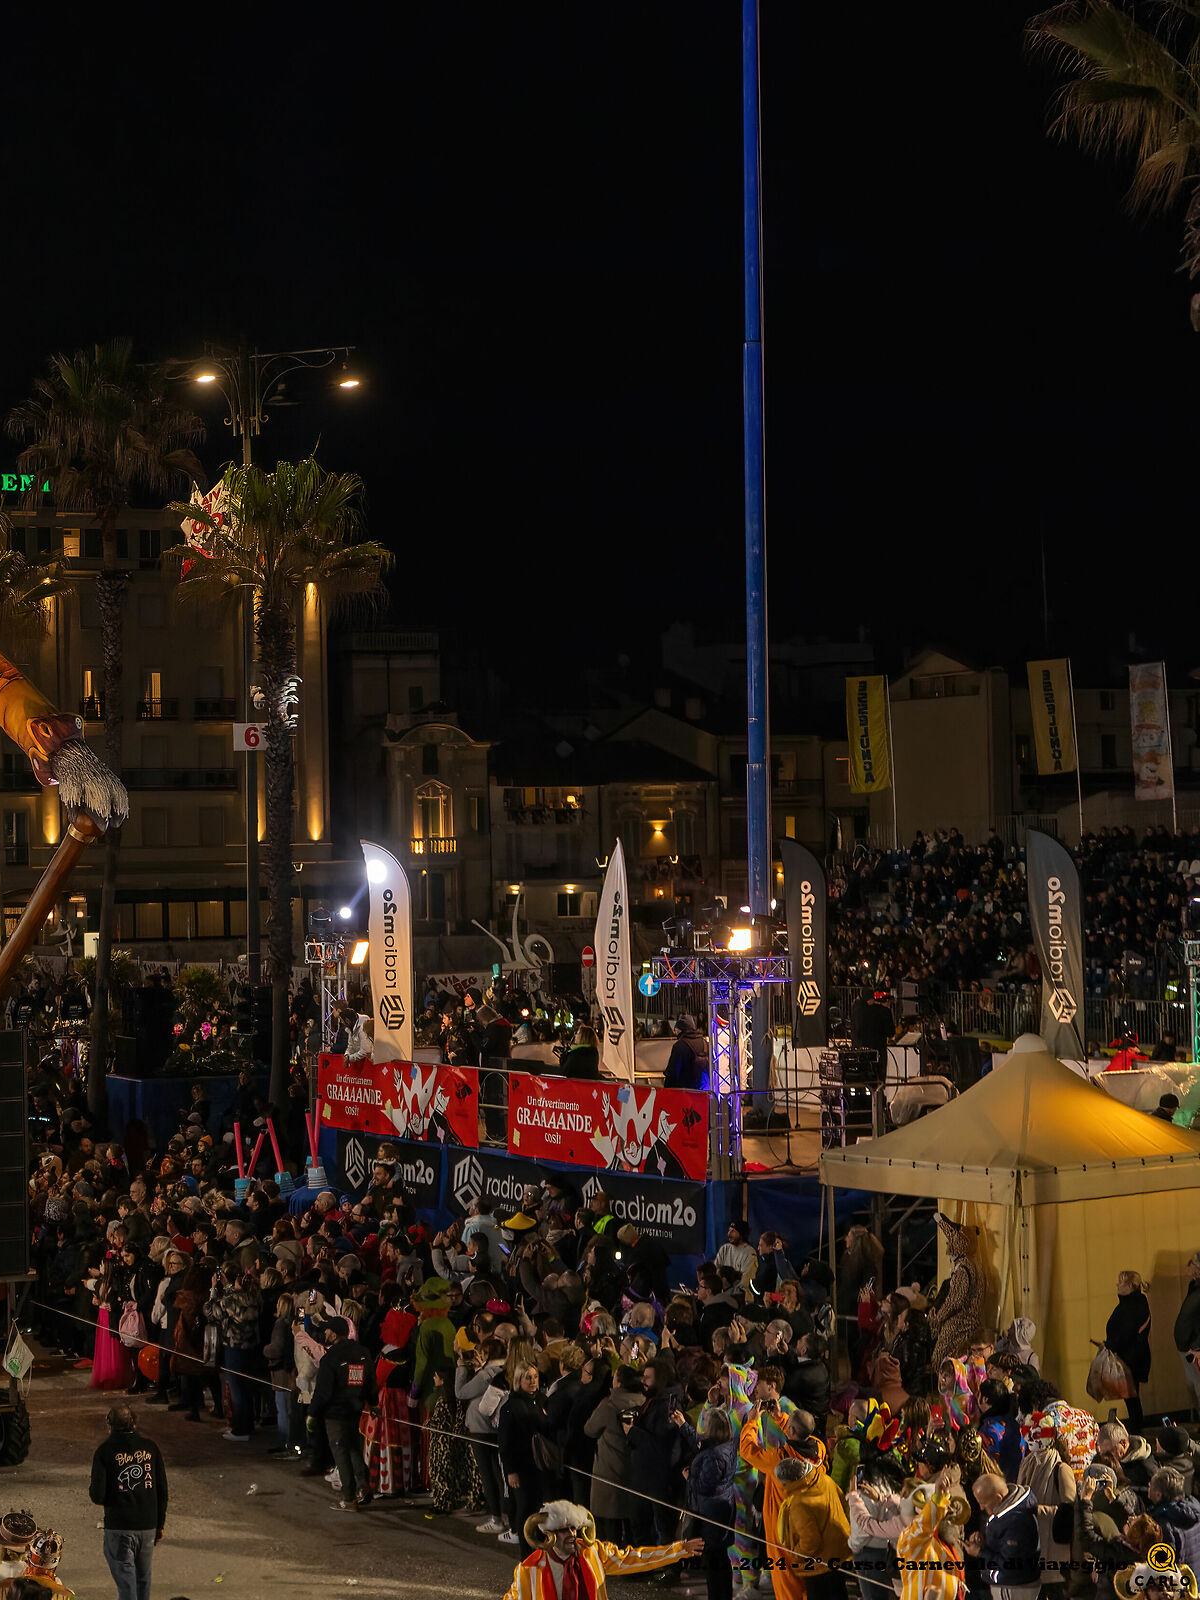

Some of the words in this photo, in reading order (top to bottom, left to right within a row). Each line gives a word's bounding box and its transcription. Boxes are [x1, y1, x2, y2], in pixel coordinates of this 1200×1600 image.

[245, 727, 260, 747] 6
[326, 1083, 383, 1106] GRAAAANDE
[527, 1095, 537, 1106] Un
[537, 1096, 580, 1111] divertimento
[516, 1106, 593, 1133] GRAAAANDE
[544, 1131, 562, 1145] così!
[115, 1453, 133, 1466] Bla
[134, 1450, 152, 1463] Bla
[145, 1463, 153, 1489] BAR
